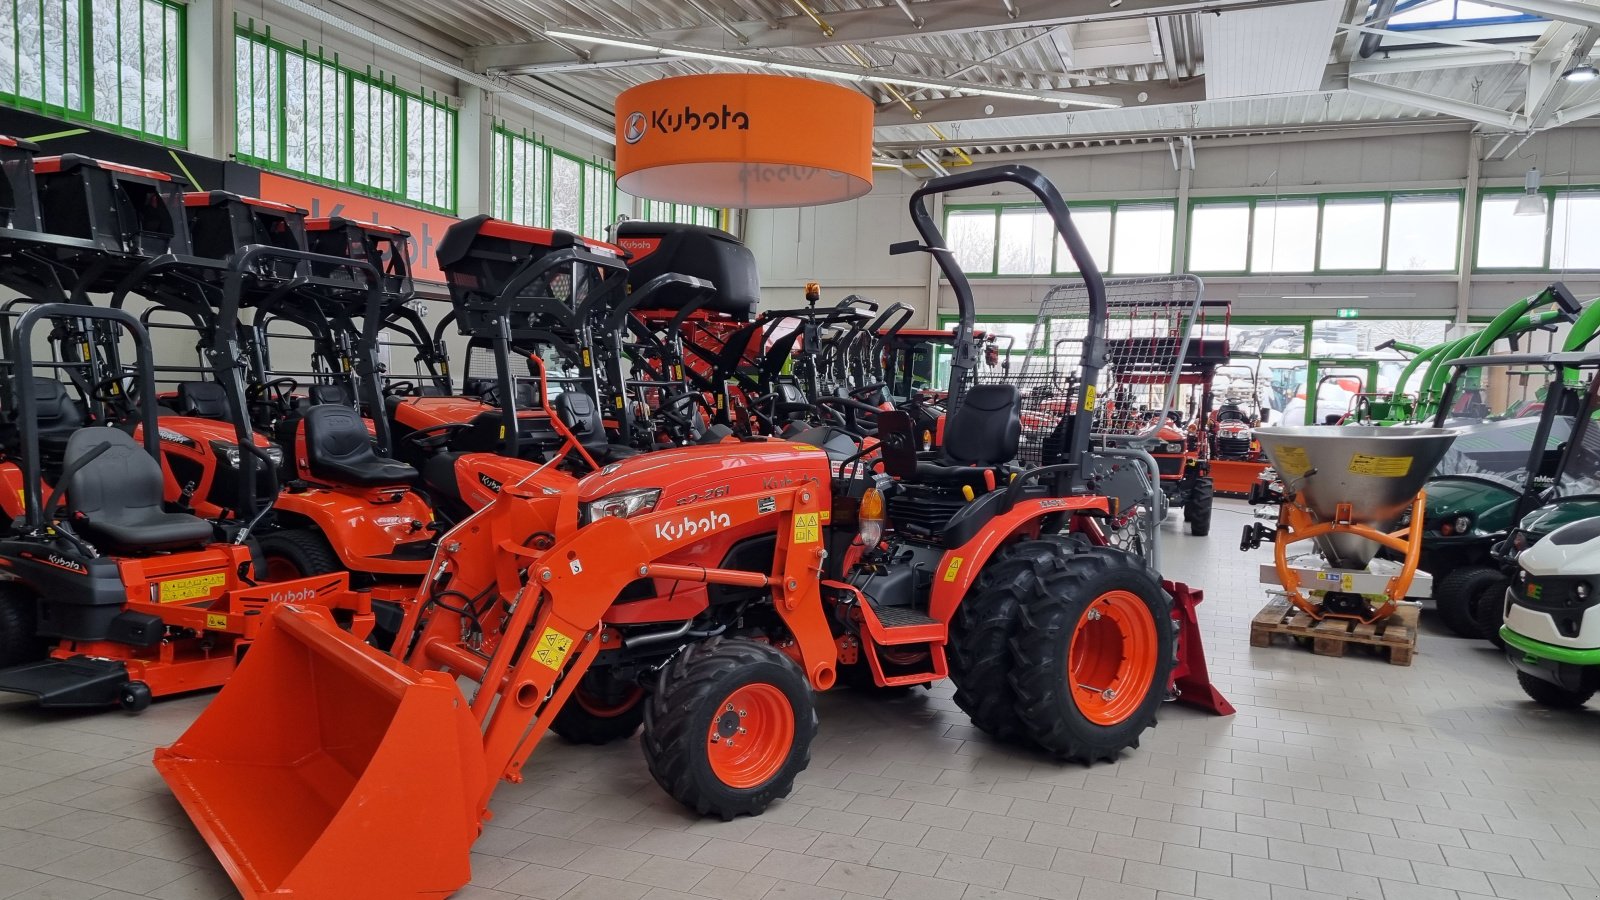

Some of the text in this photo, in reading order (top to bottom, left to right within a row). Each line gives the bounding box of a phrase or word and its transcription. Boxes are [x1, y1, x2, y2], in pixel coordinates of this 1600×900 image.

[652, 104, 749, 134] Kubota
[621, 240, 651, 249] Kubota
[482, 475, 501, 491] Kubo
[655, 510, 731, 541] Kubota
[48, 554, 80, 570] Kubota
[270, 587, 315, 603] Kubota
